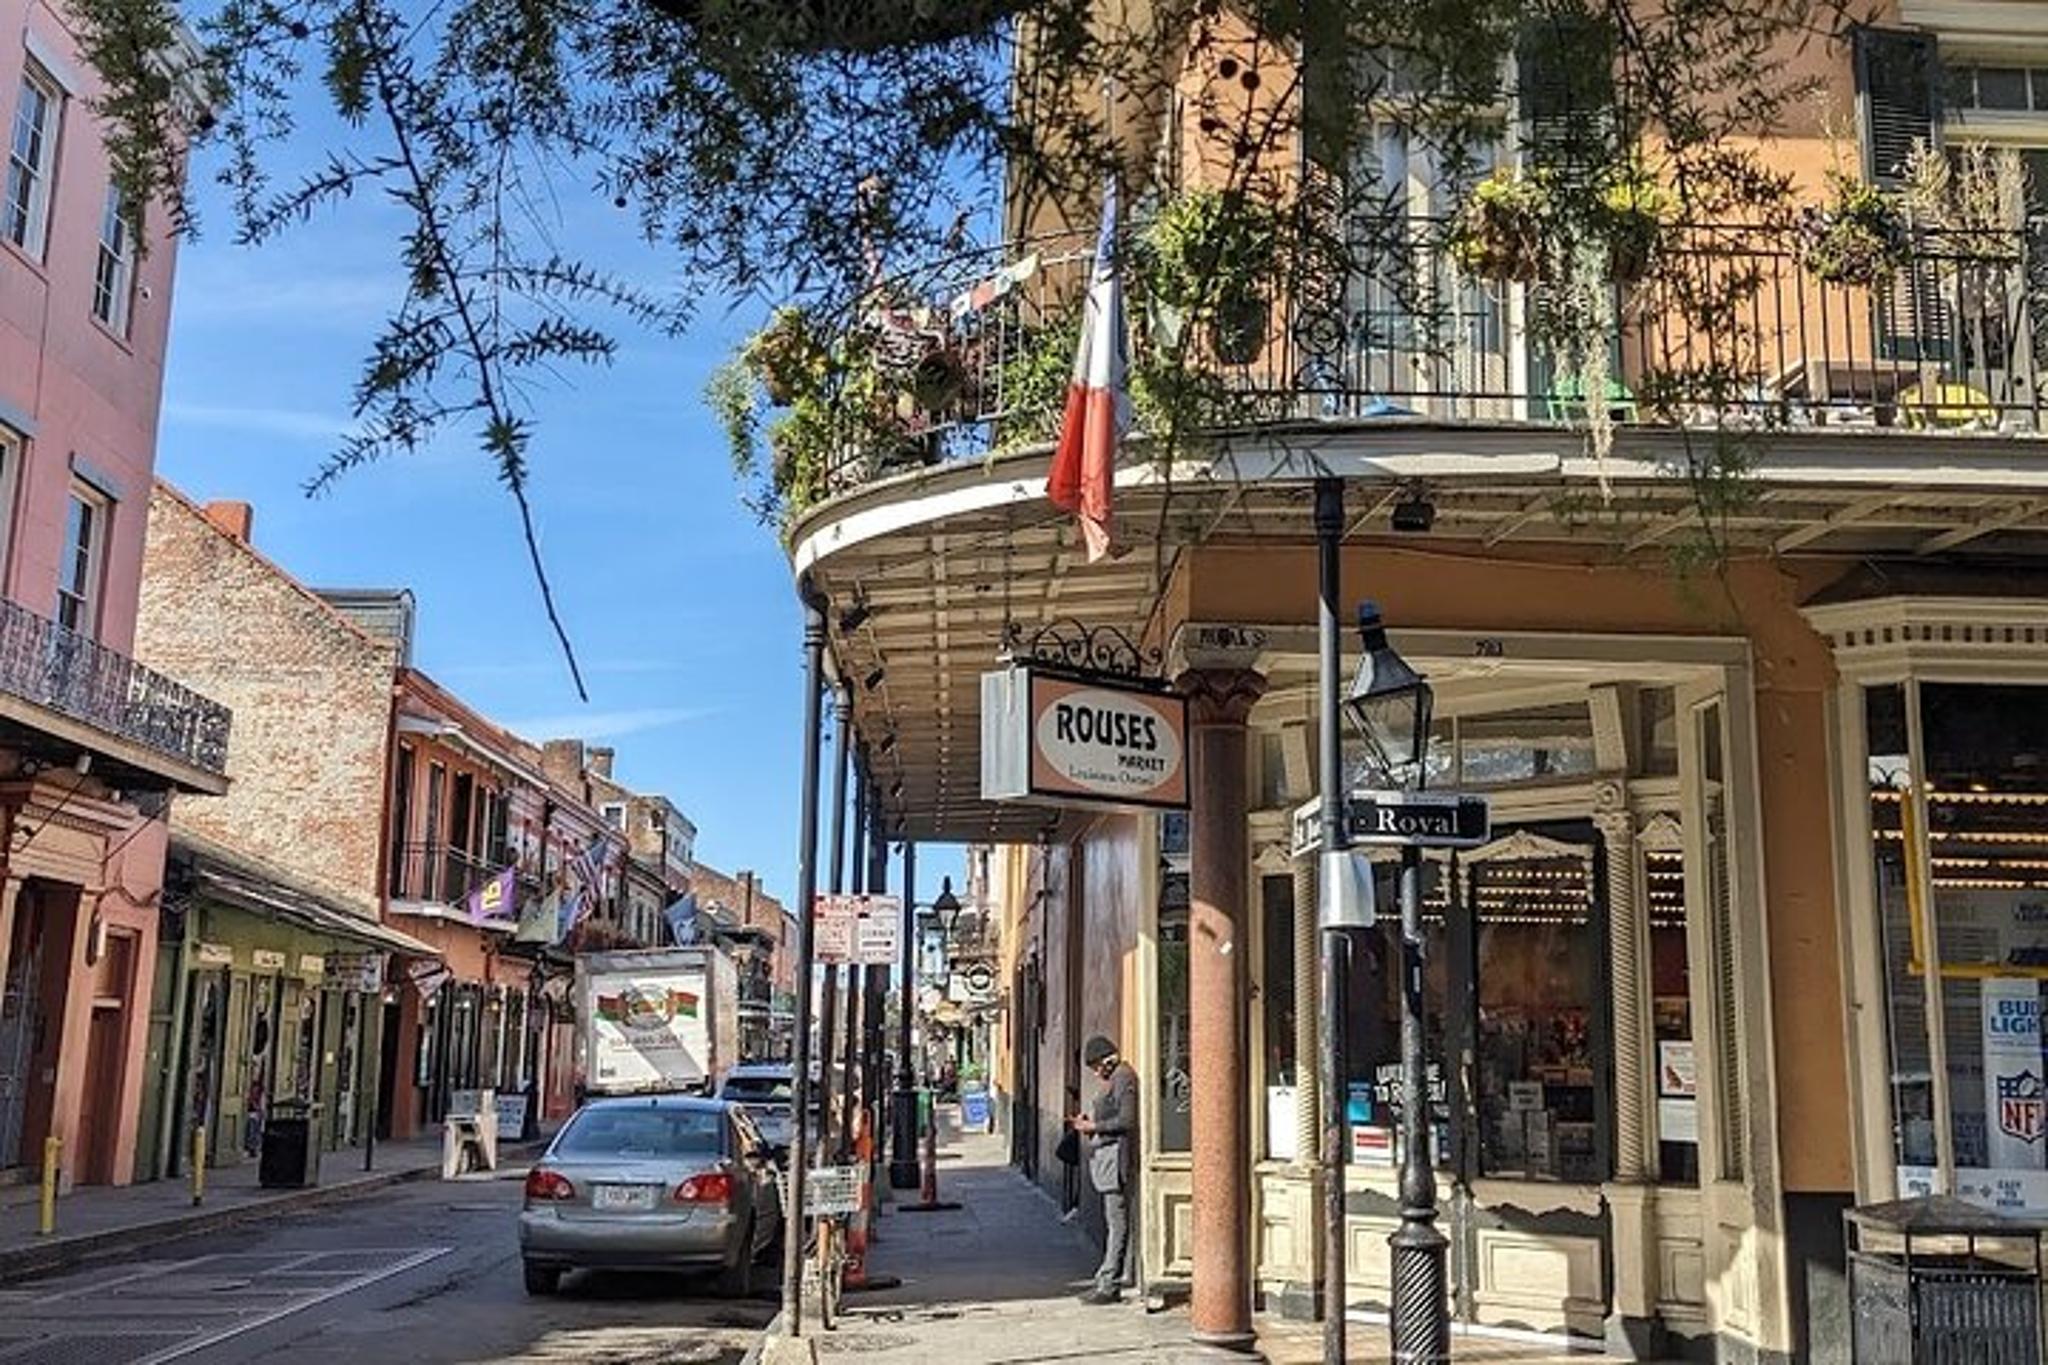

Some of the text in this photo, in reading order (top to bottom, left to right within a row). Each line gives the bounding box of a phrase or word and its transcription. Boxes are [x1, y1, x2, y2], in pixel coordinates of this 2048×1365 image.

[1056, 703, 1157, 751] ROUSES
[1117, 754, 1166, 772] MARKET
[1990, 1016, 2038, 1034] LIGH
